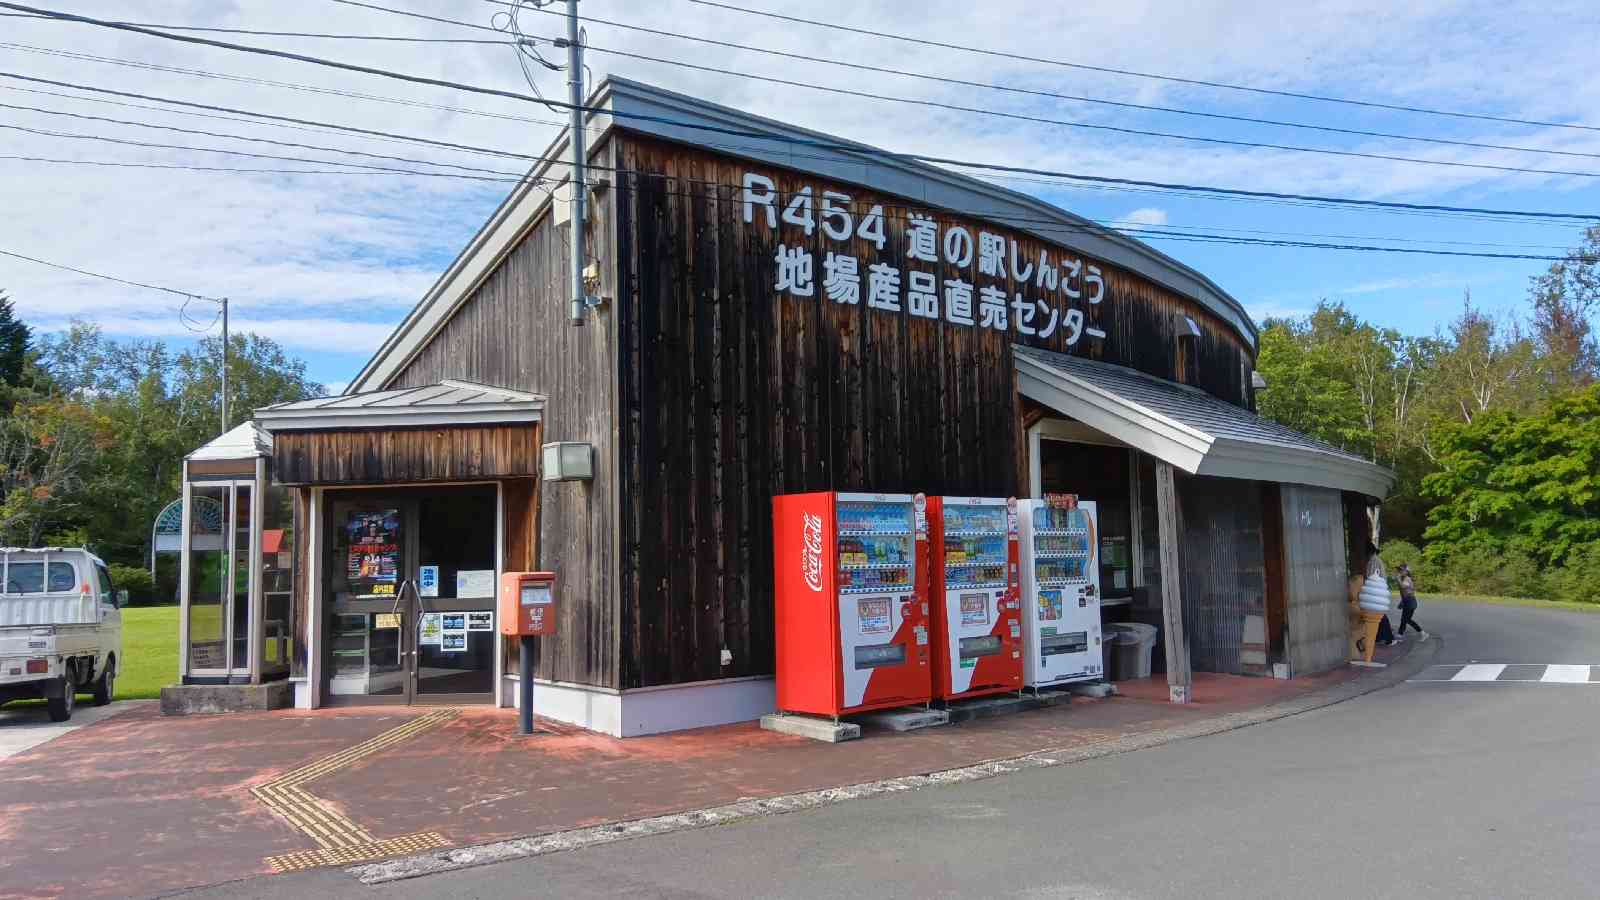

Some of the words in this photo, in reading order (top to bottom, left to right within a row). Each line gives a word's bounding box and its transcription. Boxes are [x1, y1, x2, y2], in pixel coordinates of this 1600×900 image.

[743, 172, 886, 250] R454
[775, 244, 1106, 346] 地場産品直売センター
[803, 512, 822, 592] Coca-Cola
